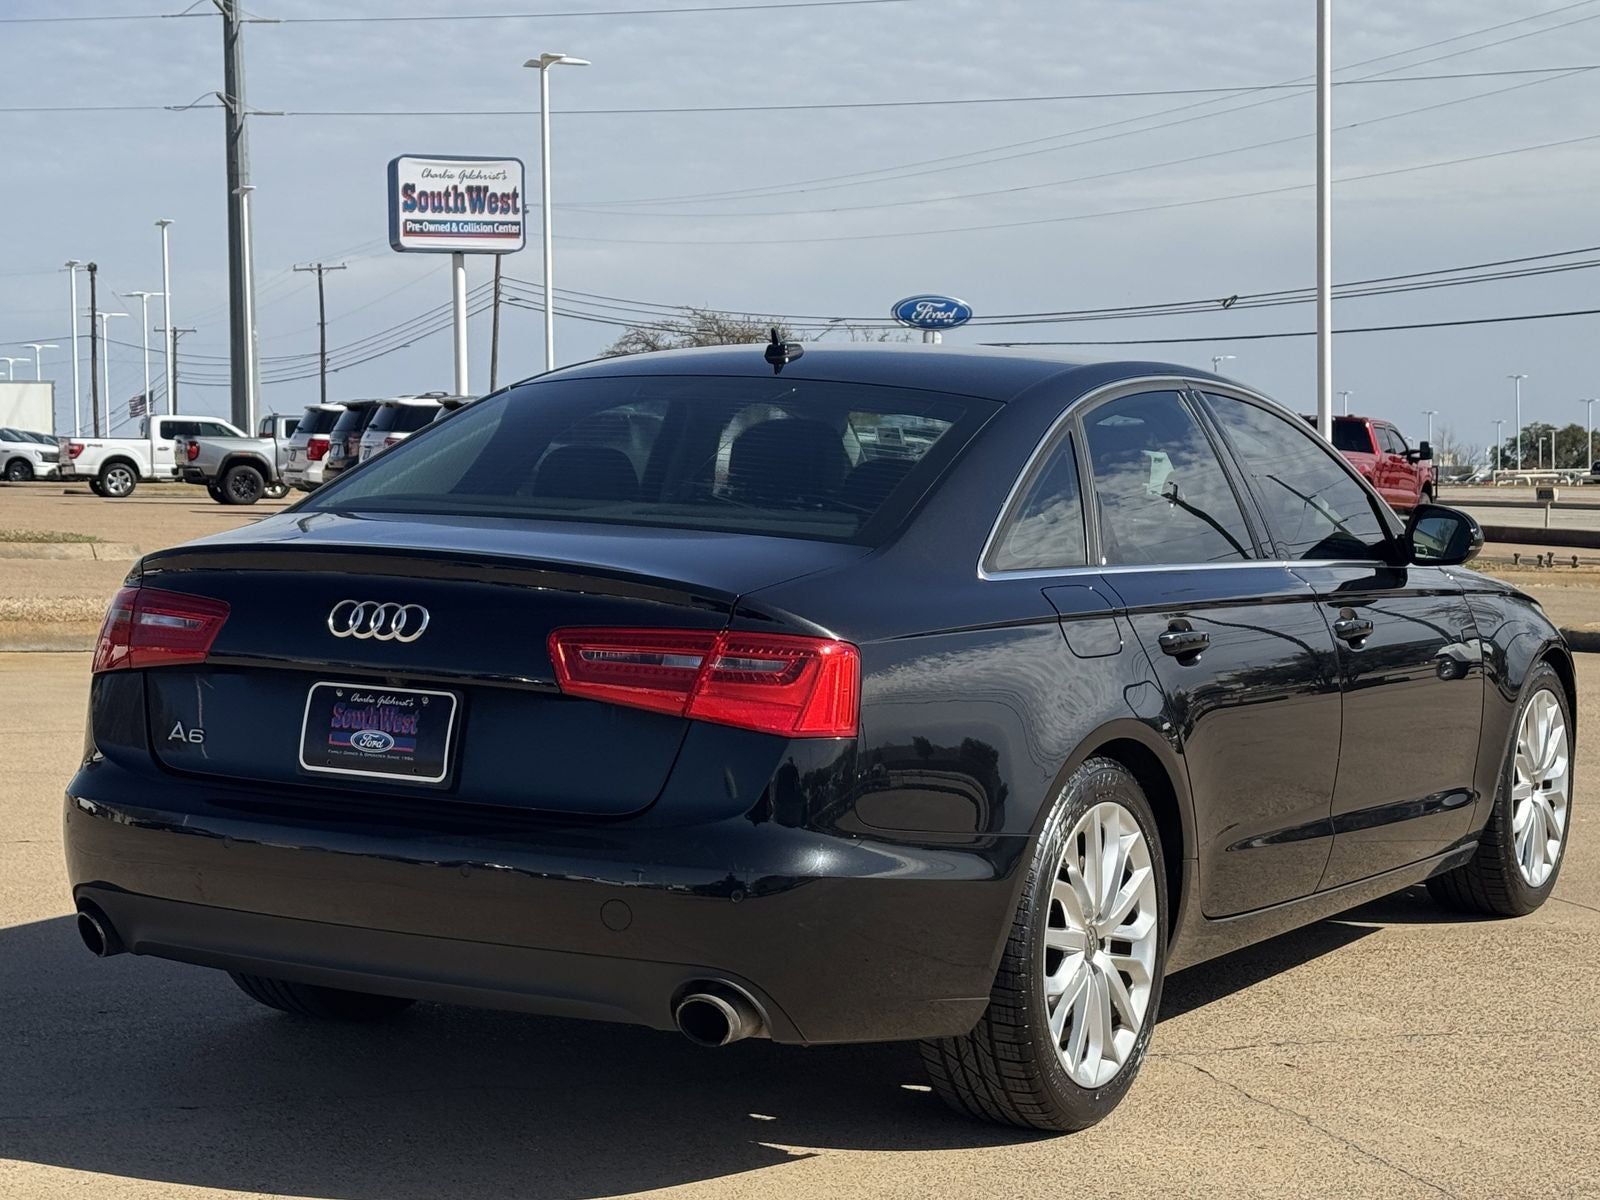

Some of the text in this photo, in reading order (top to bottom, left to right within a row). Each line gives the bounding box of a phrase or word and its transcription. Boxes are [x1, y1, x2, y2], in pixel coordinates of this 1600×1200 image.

[421, 168, 508, 184] Charlie Gilchrist's
[402, 183, 520, 214] SouthWest
[407, 222, 520, 233] Pre-Owned & Collision Center
[912, 302, 957, 322] Ford
[351, 693, 414, 708] Charlie Gilchrist's
[167, 720, 205, 743] A6
[359, 733, 385, 748] Ford
